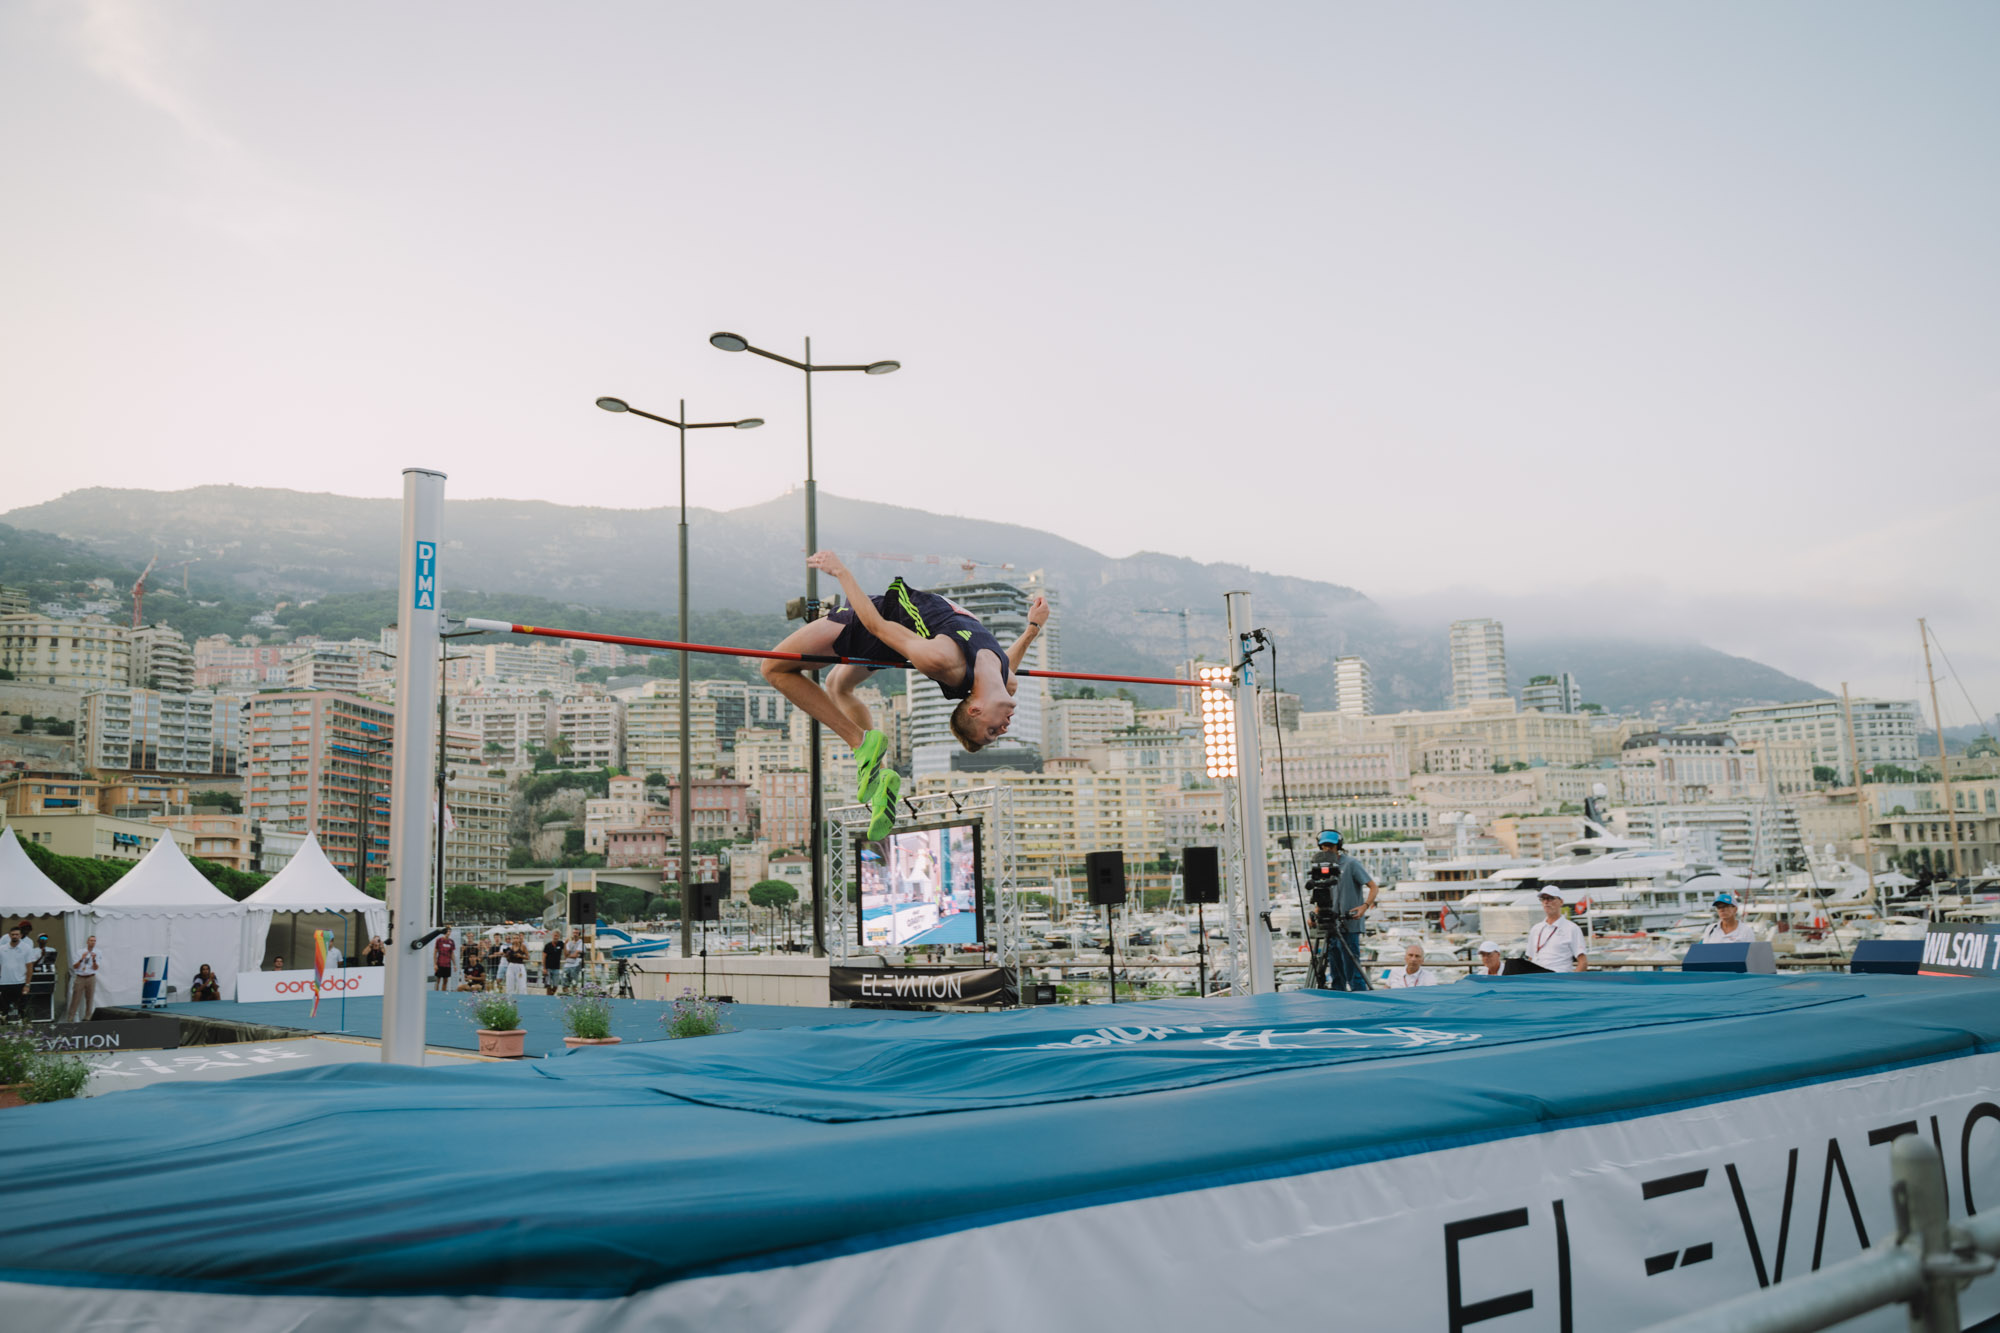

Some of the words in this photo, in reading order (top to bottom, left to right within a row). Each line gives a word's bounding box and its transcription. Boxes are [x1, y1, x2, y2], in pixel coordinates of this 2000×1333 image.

[418, 544, 434, 607] DIMA
[1922, 932, 1989, 968] WILSON
[861, 973, 962, 998] ELEVATION
